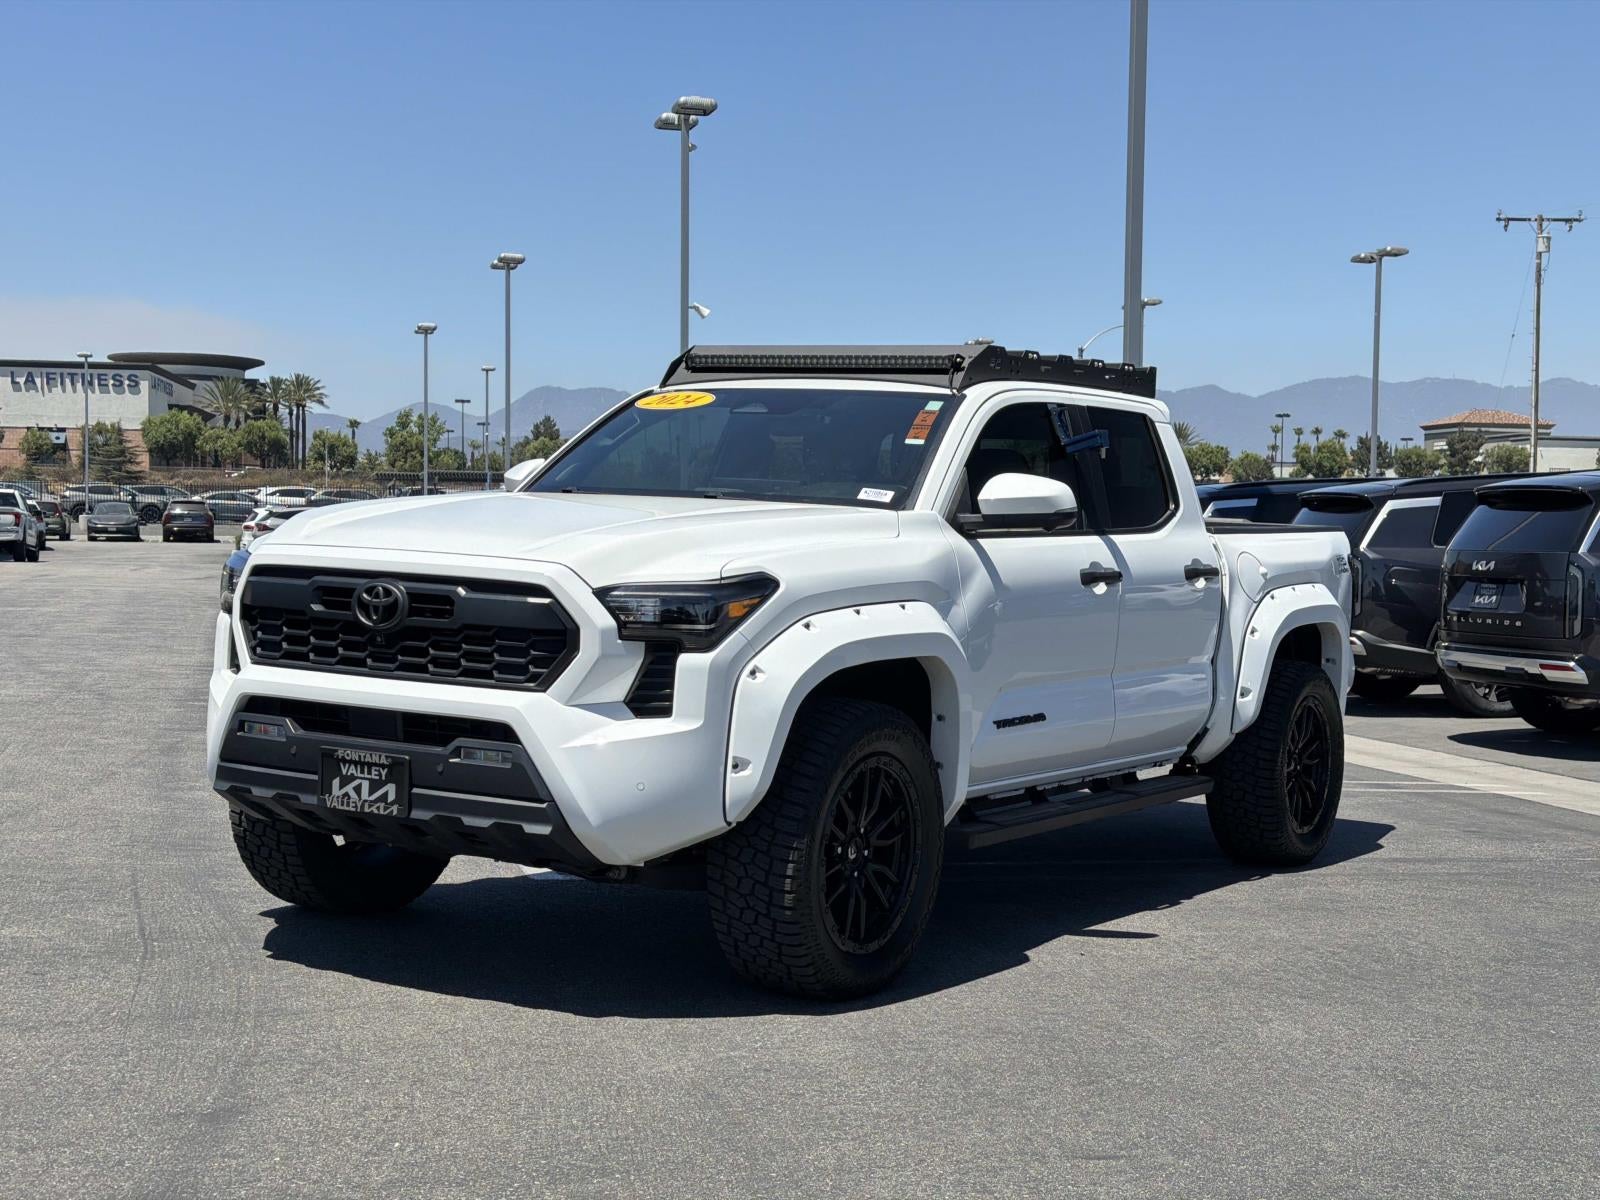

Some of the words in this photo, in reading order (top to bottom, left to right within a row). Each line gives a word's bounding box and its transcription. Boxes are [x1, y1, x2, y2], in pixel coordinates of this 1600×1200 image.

[10, 371, 37, 386] LA
[45, 372, 140, 388] FITNESS
[641, 394, 706, 406] 2024
[1446, 615, 1522, 627] TELLURIDE
[338, 750, 387, 764] FONTANA
[340, 763, 388, 781] VALLEY
[332, 776, 396, 803] KIA
[325, 794, 363, 812] VALLEY
